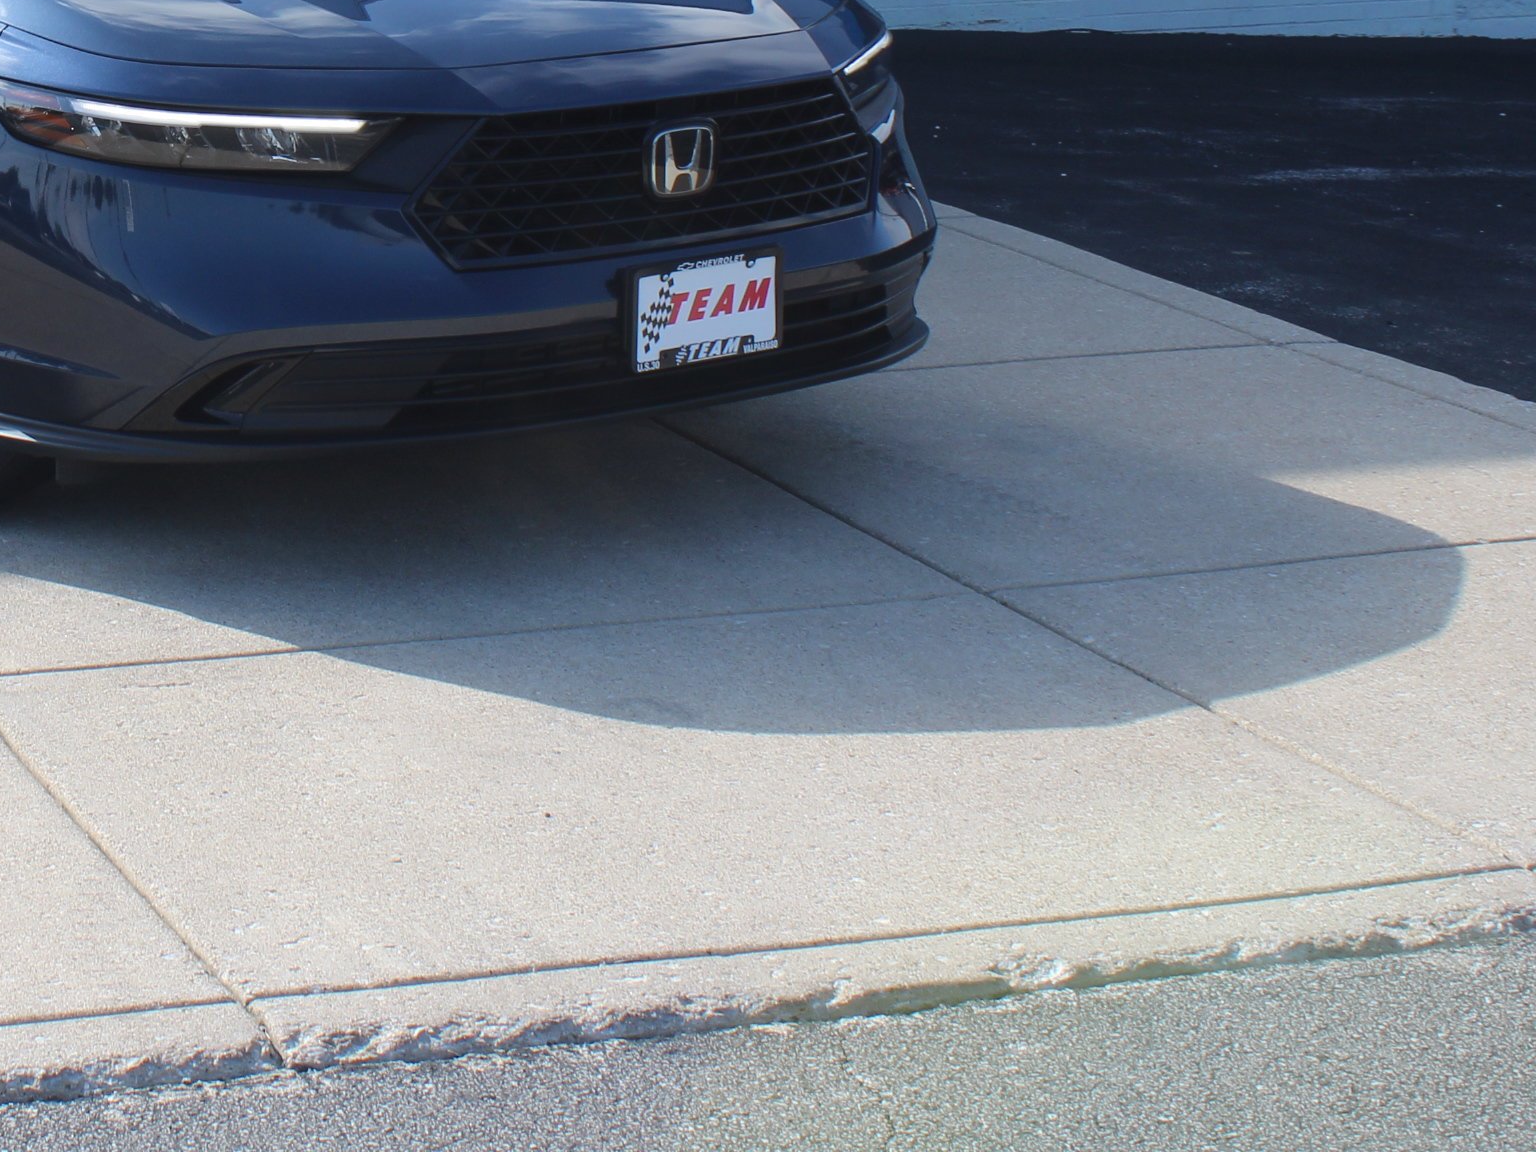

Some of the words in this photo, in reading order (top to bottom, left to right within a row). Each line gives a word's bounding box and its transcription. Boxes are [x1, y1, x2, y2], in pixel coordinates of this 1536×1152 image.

[696, 254, 744, 269] CHEVROLET
[667, 277, 771, 326] TEAM
[687, 336, 742, 362] TEAM
